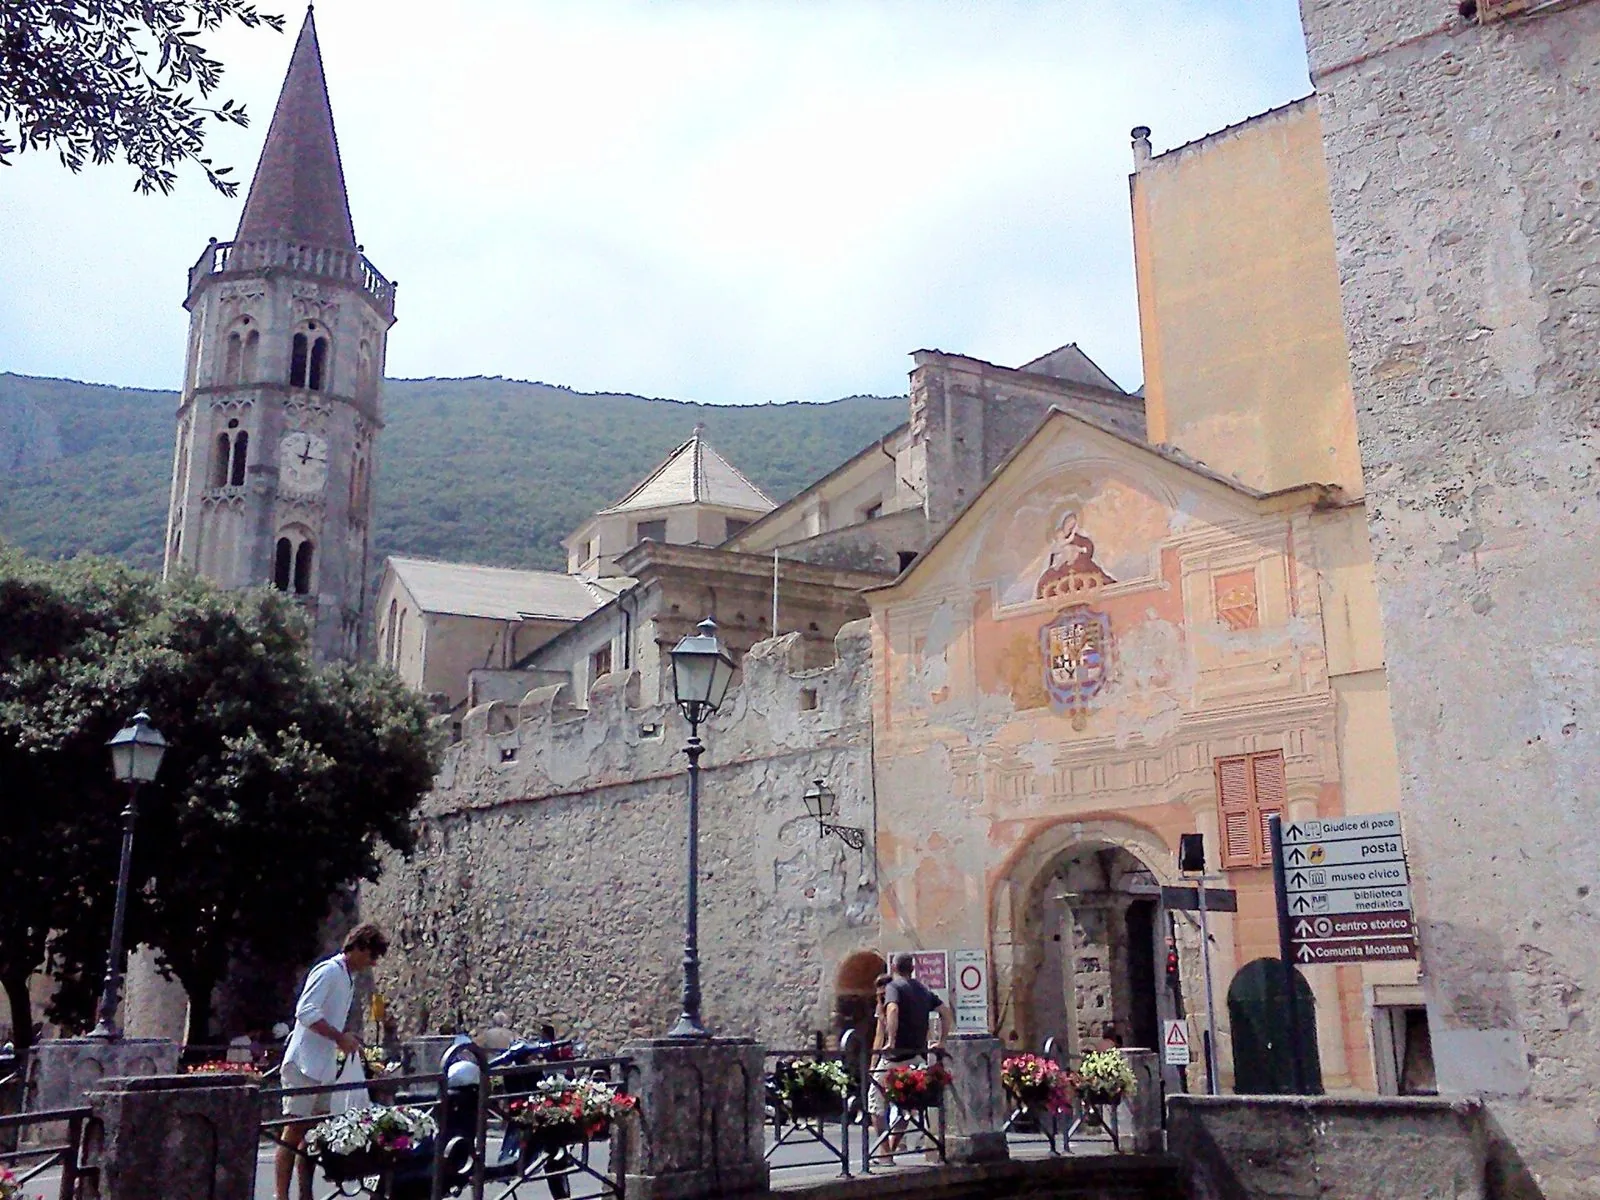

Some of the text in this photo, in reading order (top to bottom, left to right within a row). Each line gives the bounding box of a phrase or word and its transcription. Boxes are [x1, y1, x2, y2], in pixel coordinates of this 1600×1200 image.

[1323, 819, 1394, 832] Giudice di pace
[1361, 841, 1398, 857] posta
[1331, 869, 1400, 882] museo civico
[1354, 890, 1402, 900] biblioteca
[1335, 919, 1407, 931] centro storico
[1365, 945, 1409, 955] Montana
